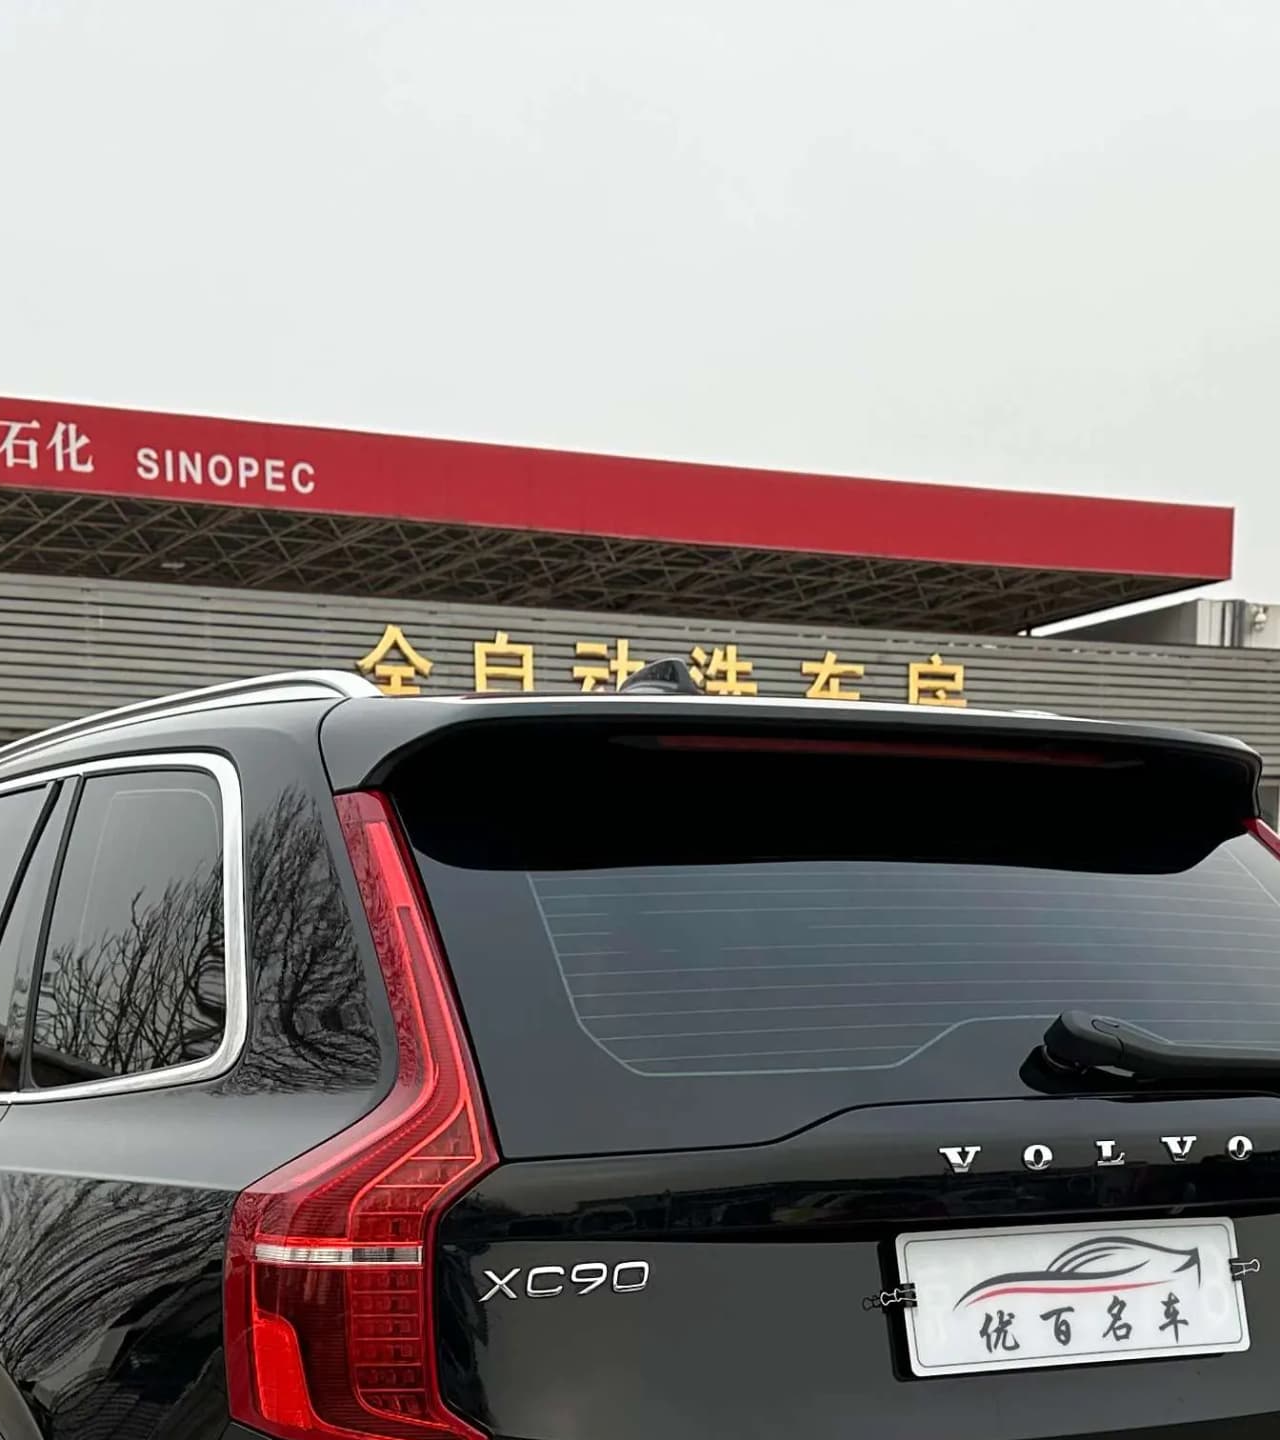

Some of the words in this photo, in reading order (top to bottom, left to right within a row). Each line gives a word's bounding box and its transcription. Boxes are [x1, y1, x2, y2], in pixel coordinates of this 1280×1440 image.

[136, 448, 315, 494] SINOPEC
[939, 1135, 1253, 1173] VOLVO
[479, 1261, 650, 1301] XC90
[979, 1292, 1189, 1353] 优百名车
